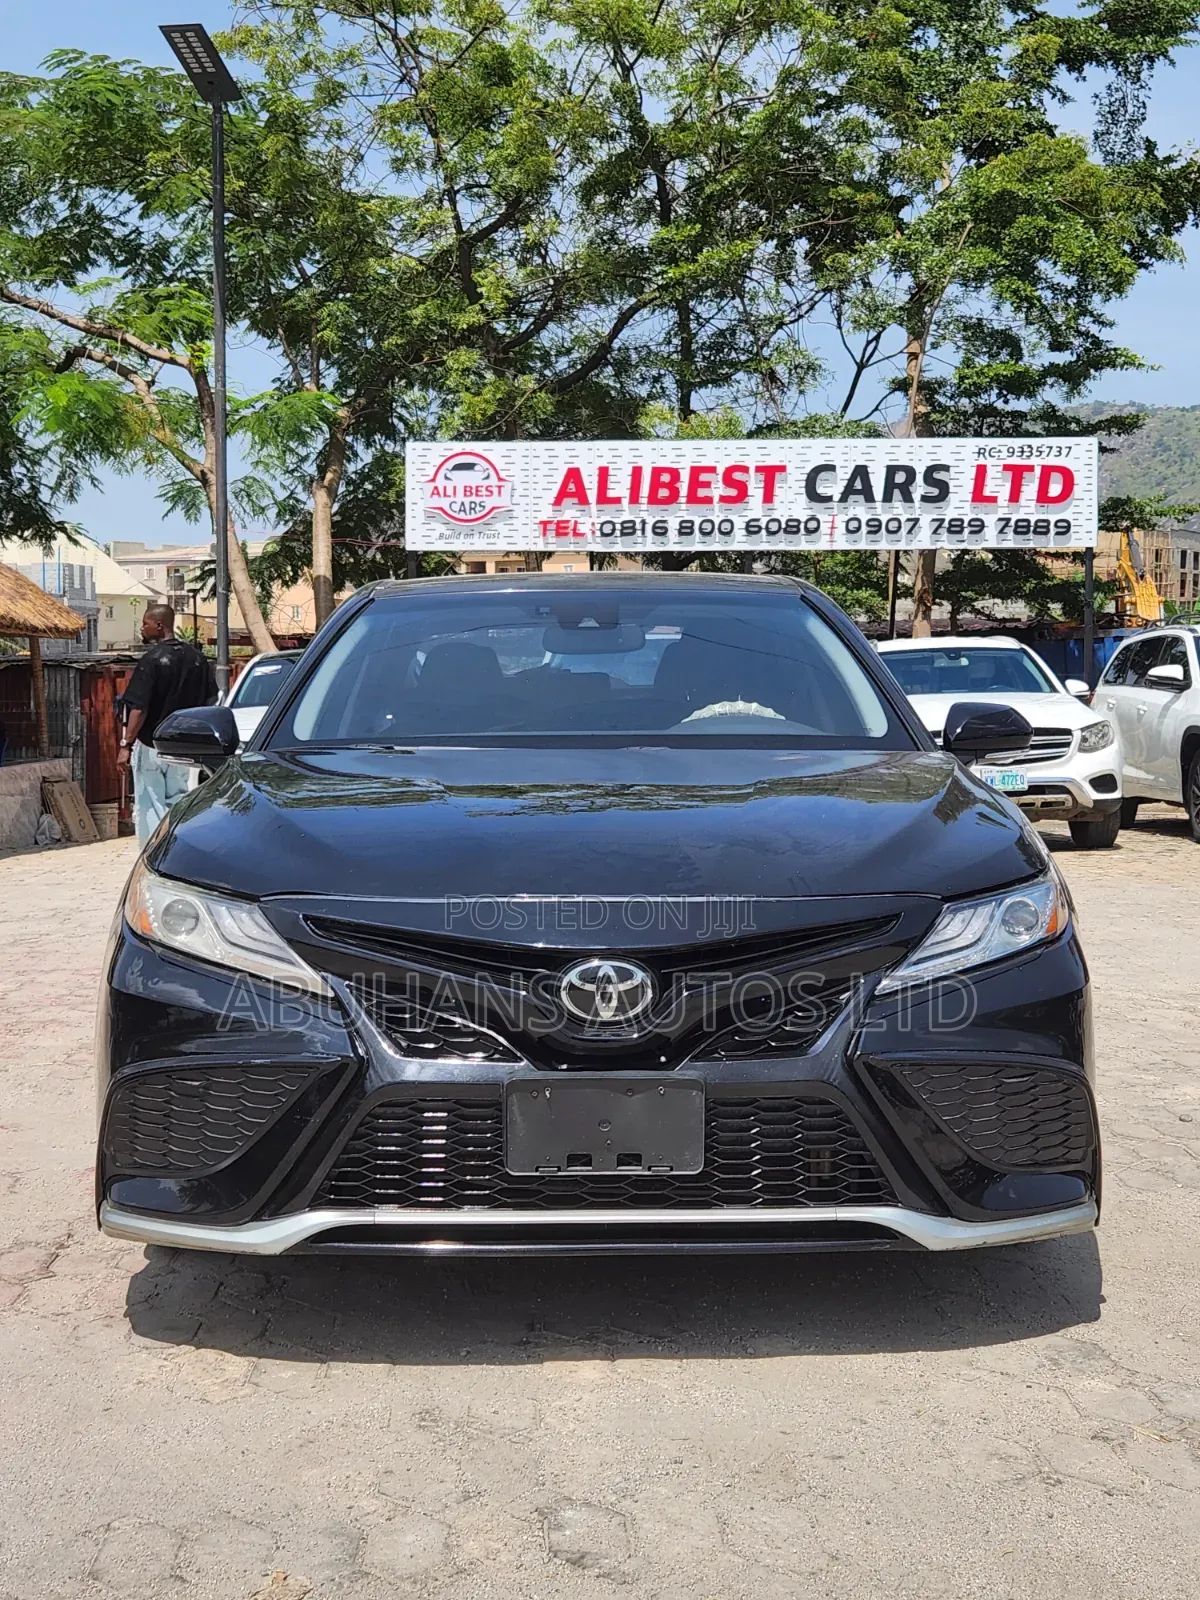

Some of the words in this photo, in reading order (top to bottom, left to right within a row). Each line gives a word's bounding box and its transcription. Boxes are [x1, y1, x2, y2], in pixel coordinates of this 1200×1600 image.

[430, 485, 458, 498] ALI
[463, 484, 506, 497] BEST
[552, 464, 787, 507] ALIBEST
[805, 463, 951, 504] CARS
[970, 464, 1076, 505] LTD
[449, 500, 487, 516] CARS
[600, 518, 670, 538] 0816
[678, 518, 736, 537] 800
[744, 516, 821, 536] 6080
[845, 516, 920, 536] 0907
[929, 516, 986, 536] 789
[997, 516, 1072, 537] 7889
[438, 532, 462, 541] Build
[477, 531, 501, 540] Trust
